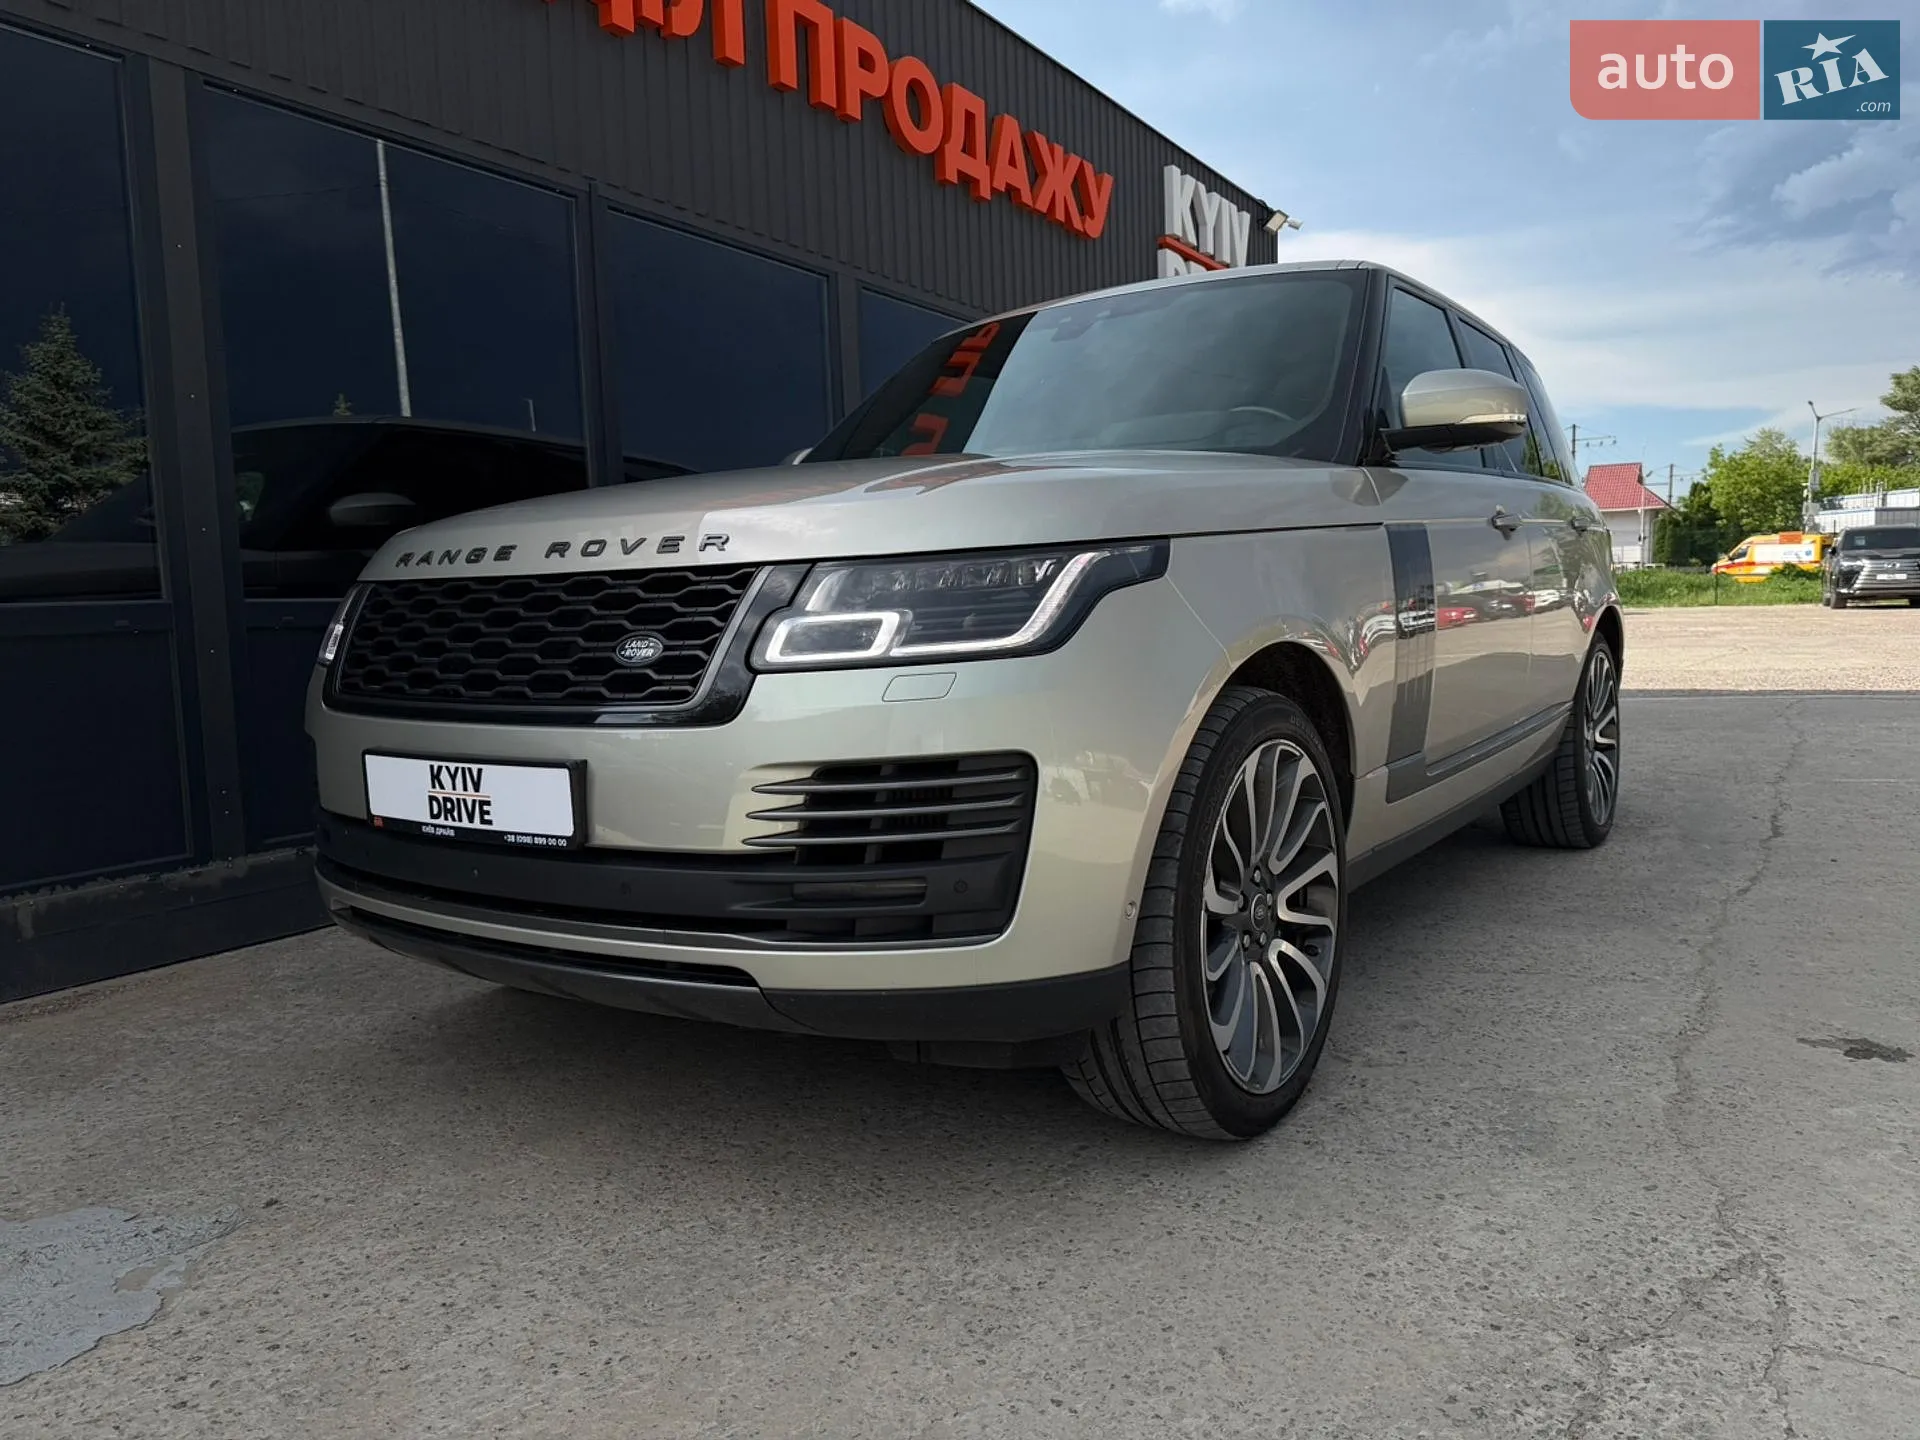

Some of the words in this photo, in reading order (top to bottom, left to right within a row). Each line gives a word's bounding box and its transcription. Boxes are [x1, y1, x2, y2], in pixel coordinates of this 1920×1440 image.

[767, 0, 1113, 239] ПРОДАЖУ
[1163, 164, 1251, 268] KYIV
[395, 544, 517, 568] RANGE
[545, 533, 731, 559] ROVER
[625, 640, 649, 648] LAND
[625, 648, 654, 657] ROVER
[429, 764, 483, 793] KYIV
[428, 795, 493, 826] DRIVE
